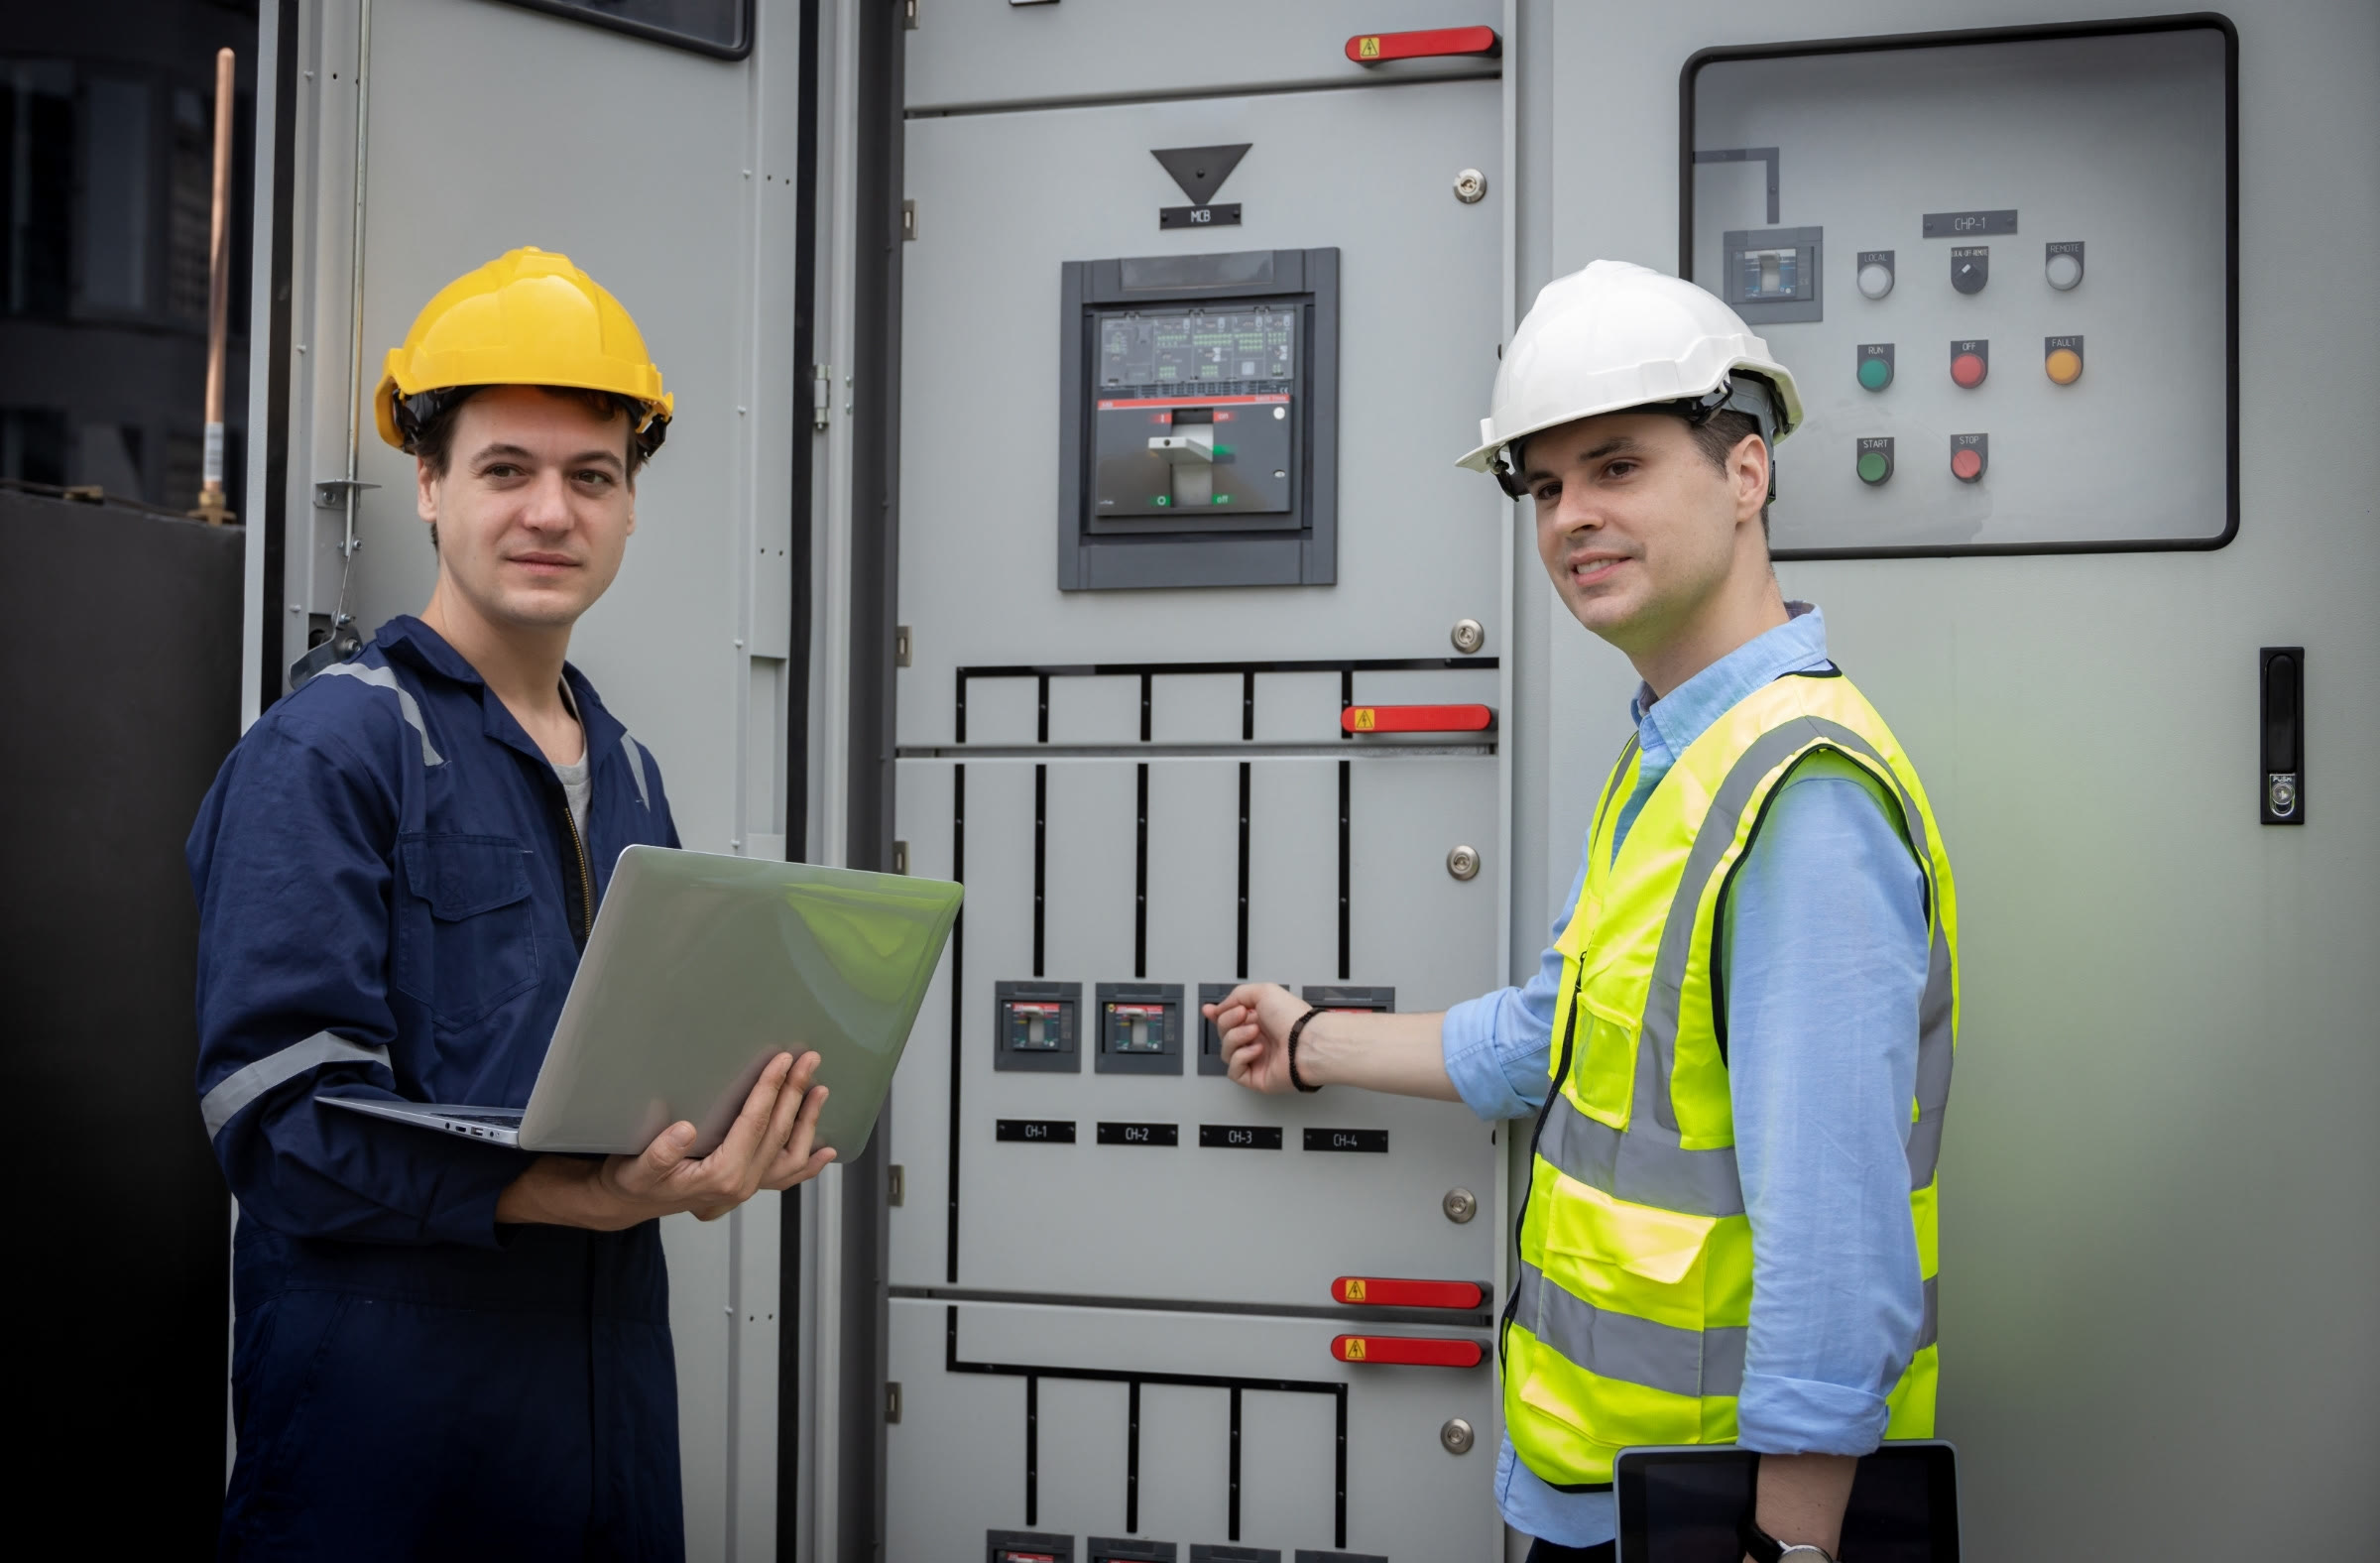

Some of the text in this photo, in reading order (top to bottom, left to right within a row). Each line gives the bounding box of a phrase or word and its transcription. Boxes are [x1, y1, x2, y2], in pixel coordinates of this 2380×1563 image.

[1191, 209, 1211, 223] MCB
[1955, 216, 1985, 231] CHP-1
[2050, 244, 2081, 254] REMOTE
[1864, 253, 1887, 263] LOCAL
[1963, 342, 1976, 351] OFF
[2052, 338, 2077, 347] FAULT
[1868, 346, 1883, 355] RUN
[1863, 439, 1888, 449] START
[1024, 1125, 1048, 1138] CH-1
[1125, 1128, 1149, 1142] CH-2
[1228, 1131, 1252, 1144] CH-3
[1333, 1134, 1359, 1147] CH-4
